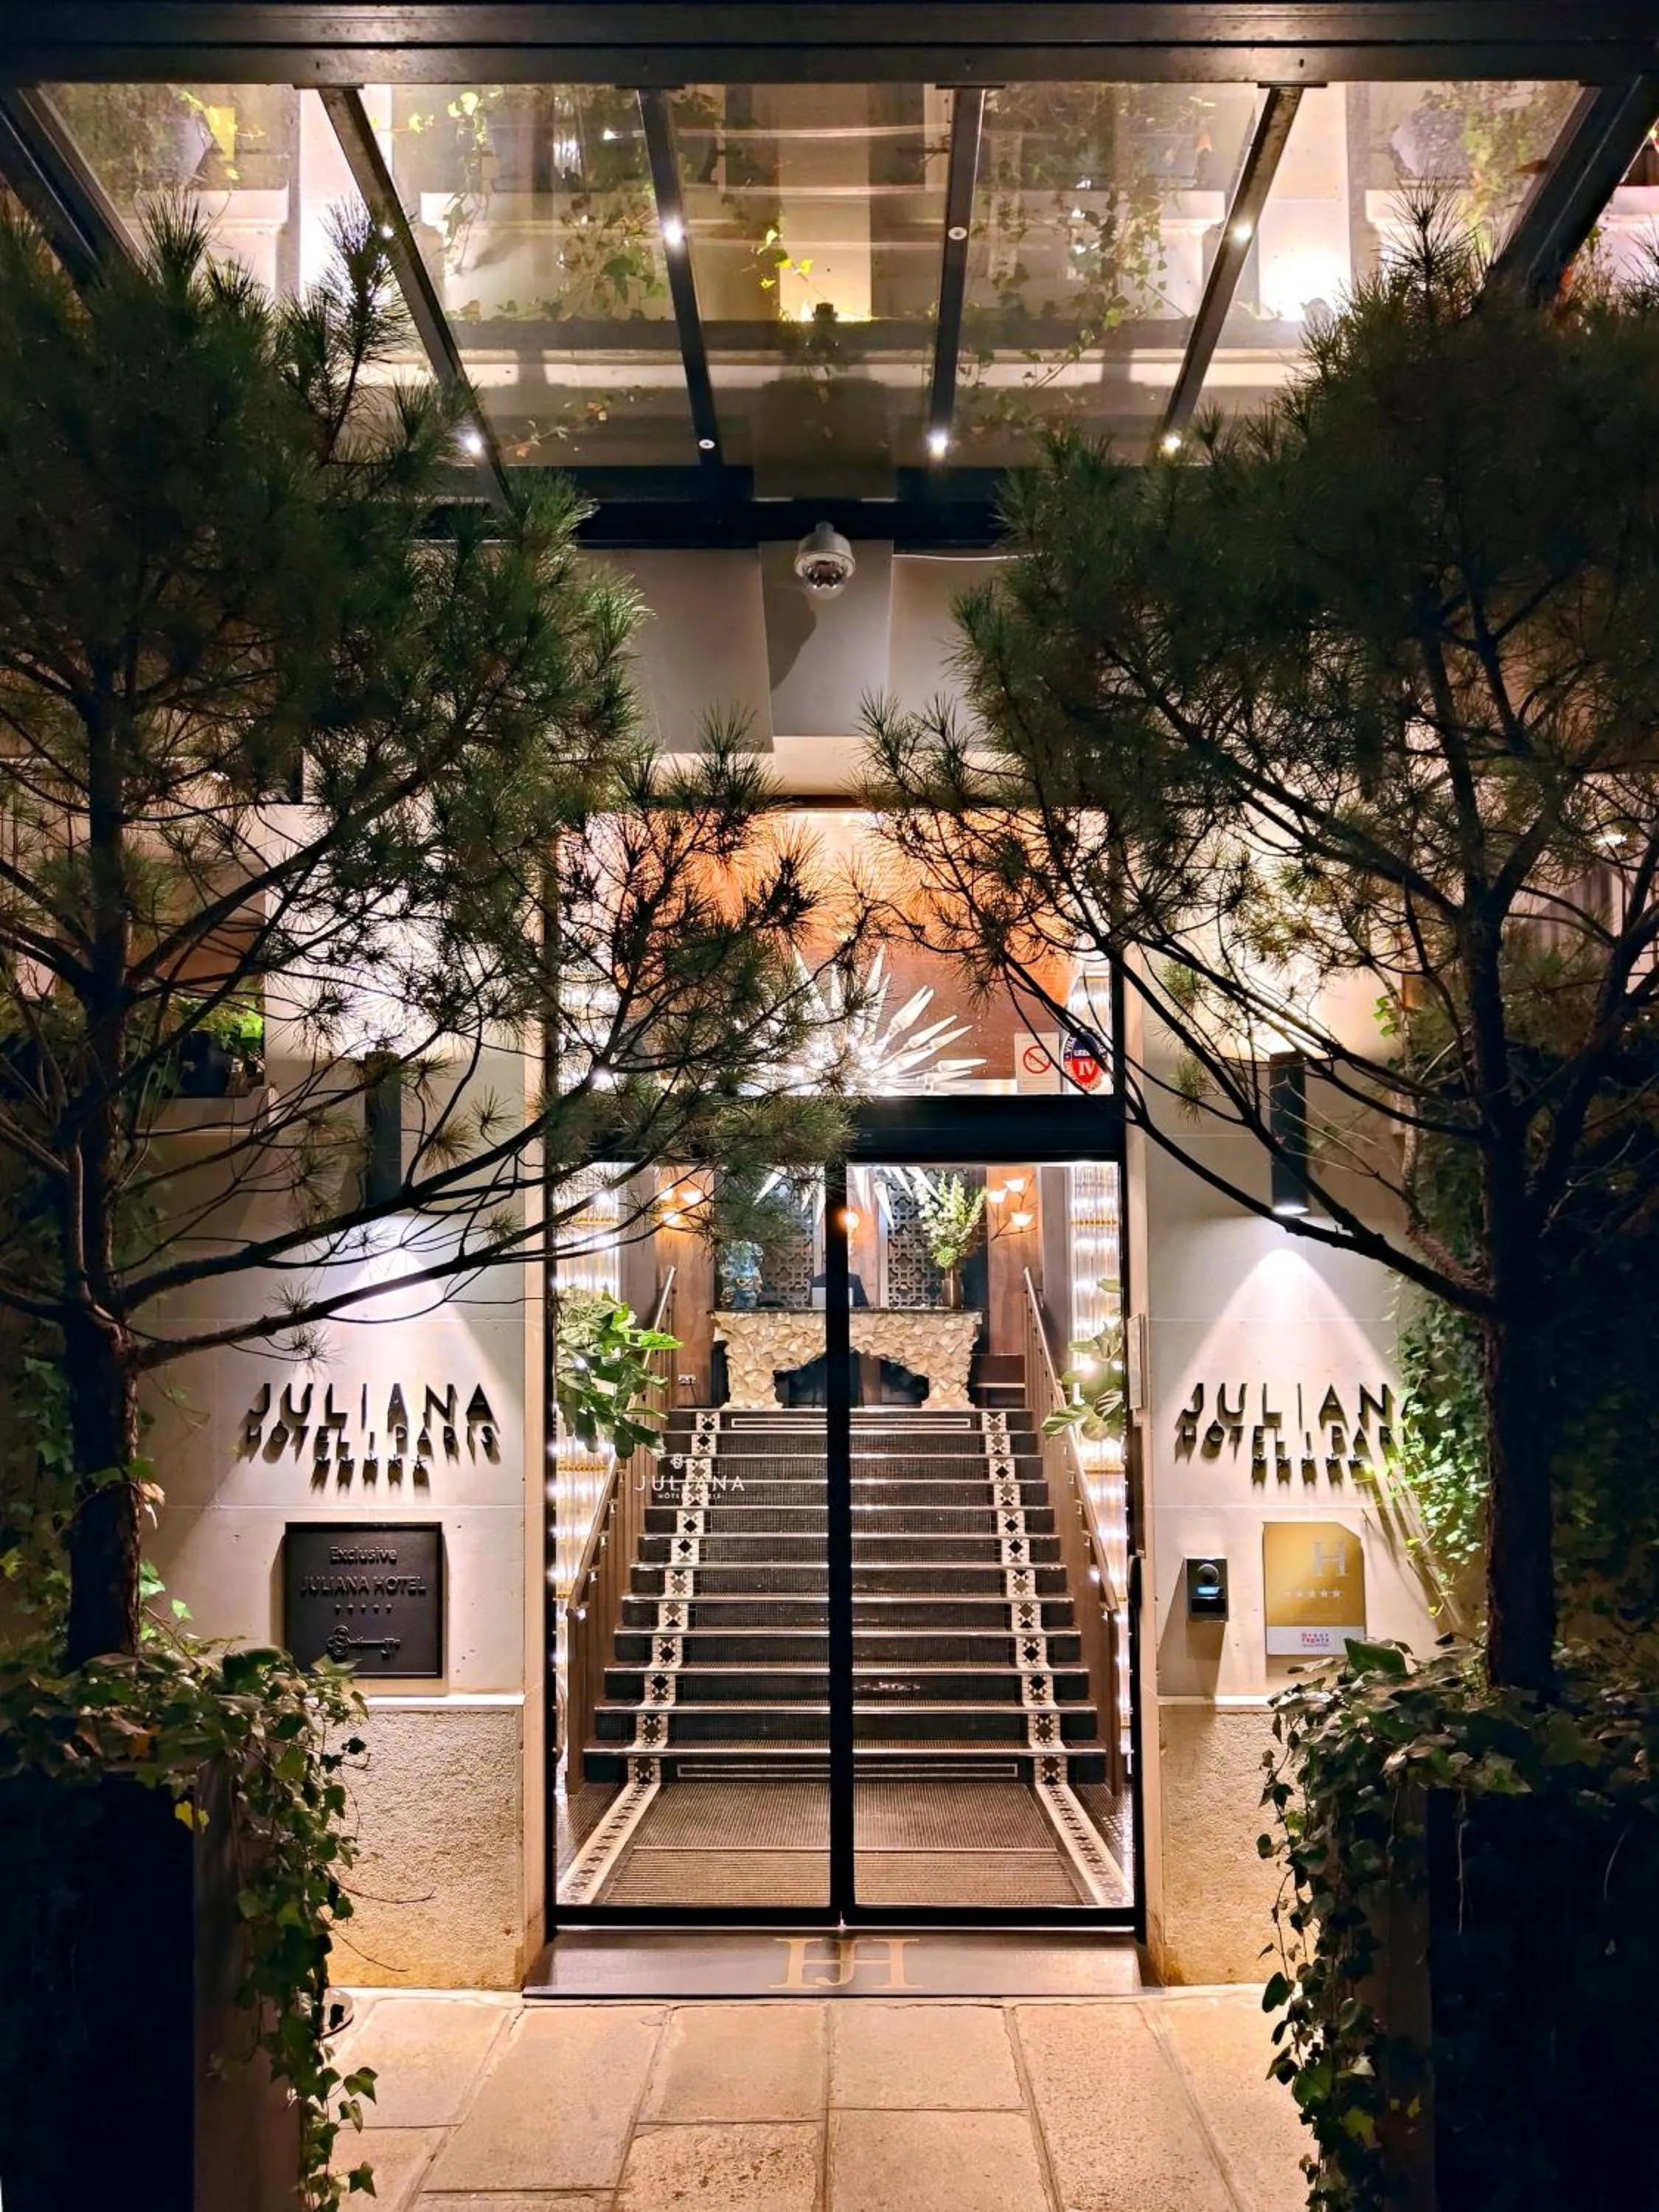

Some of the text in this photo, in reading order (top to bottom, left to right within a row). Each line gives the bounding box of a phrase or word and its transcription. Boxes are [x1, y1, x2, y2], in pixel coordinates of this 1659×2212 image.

[247, 1382, 495, 1419] JULIANA
[246, 1420, 494, 1444] HÔTEL PARIS
[634, 1475, 745, 1491] JULANA
[330, 1546, 397, 1565] Exclusive
[1312, 1542, 1348, 1576] H
[299, 1576, 427, 1595] JULIANA HOTEL
